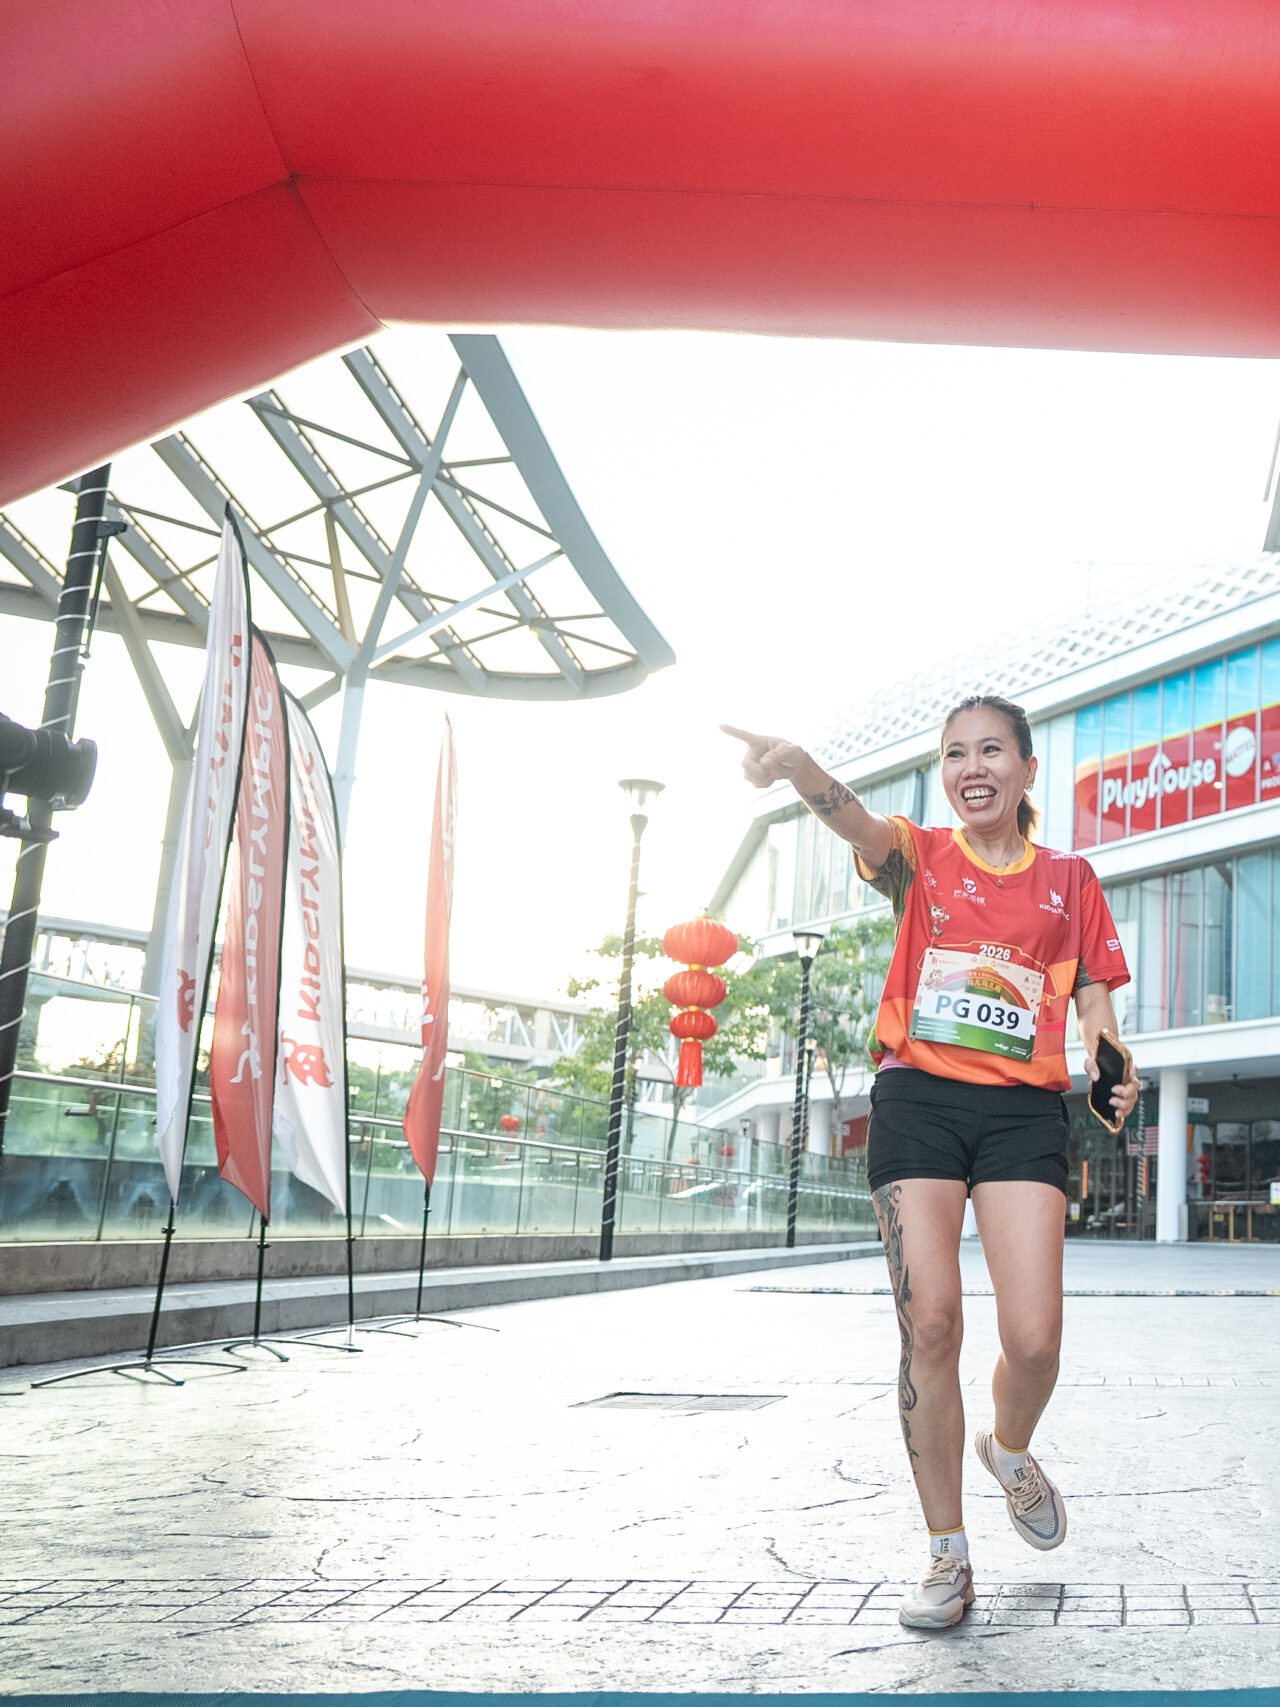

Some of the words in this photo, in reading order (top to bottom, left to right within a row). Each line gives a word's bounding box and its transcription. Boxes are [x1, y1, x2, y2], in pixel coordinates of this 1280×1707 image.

[979, 945, 1011, 961] 2026
[935, 995, 971, 1019] PG
[976, 1003, 1020, 1030] 039
